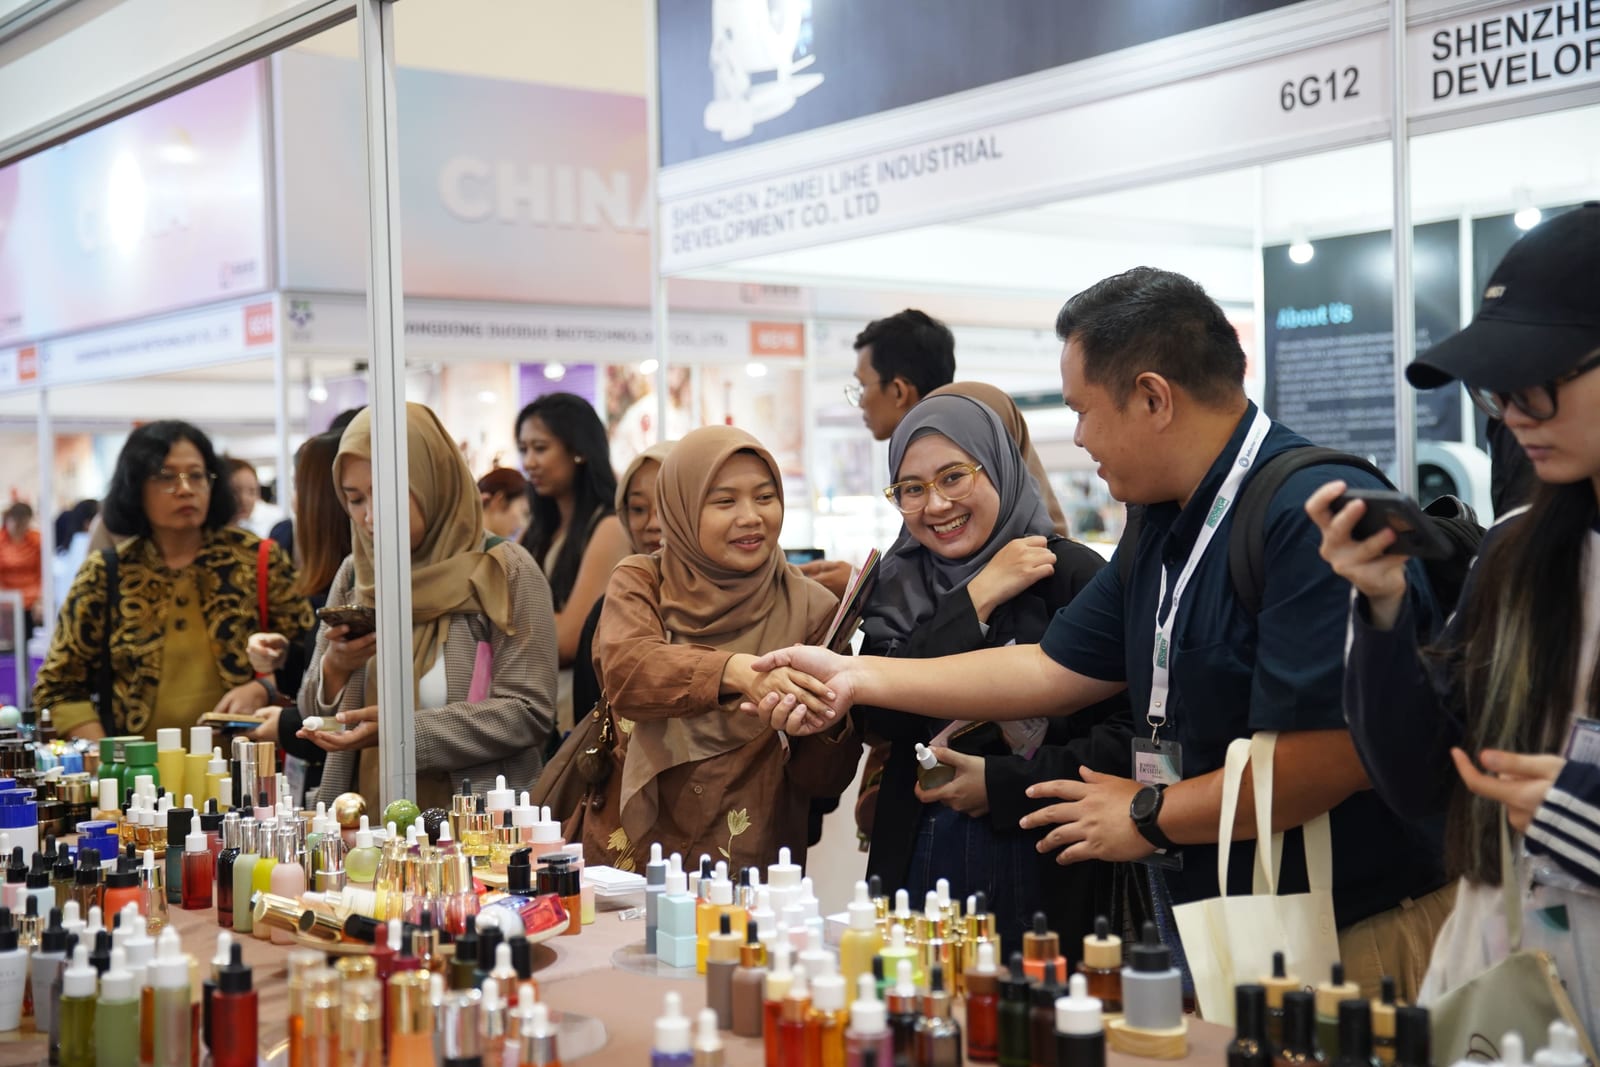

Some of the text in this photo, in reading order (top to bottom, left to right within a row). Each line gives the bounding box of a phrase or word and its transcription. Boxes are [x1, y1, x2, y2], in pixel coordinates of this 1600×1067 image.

[1281, 65, 1359, 111] 6G12
[673, 135, 1003, 231] SHENZHEN ZHIMEI LIHE INDUSTRIAL
[673, 208, 795, 254] DEVELOPMENT
[844, 191, 880, 220] LTD
[554, 326, 653, 343] BIOTECHNOLO
[1276, 302, 1353, 329] About Us
